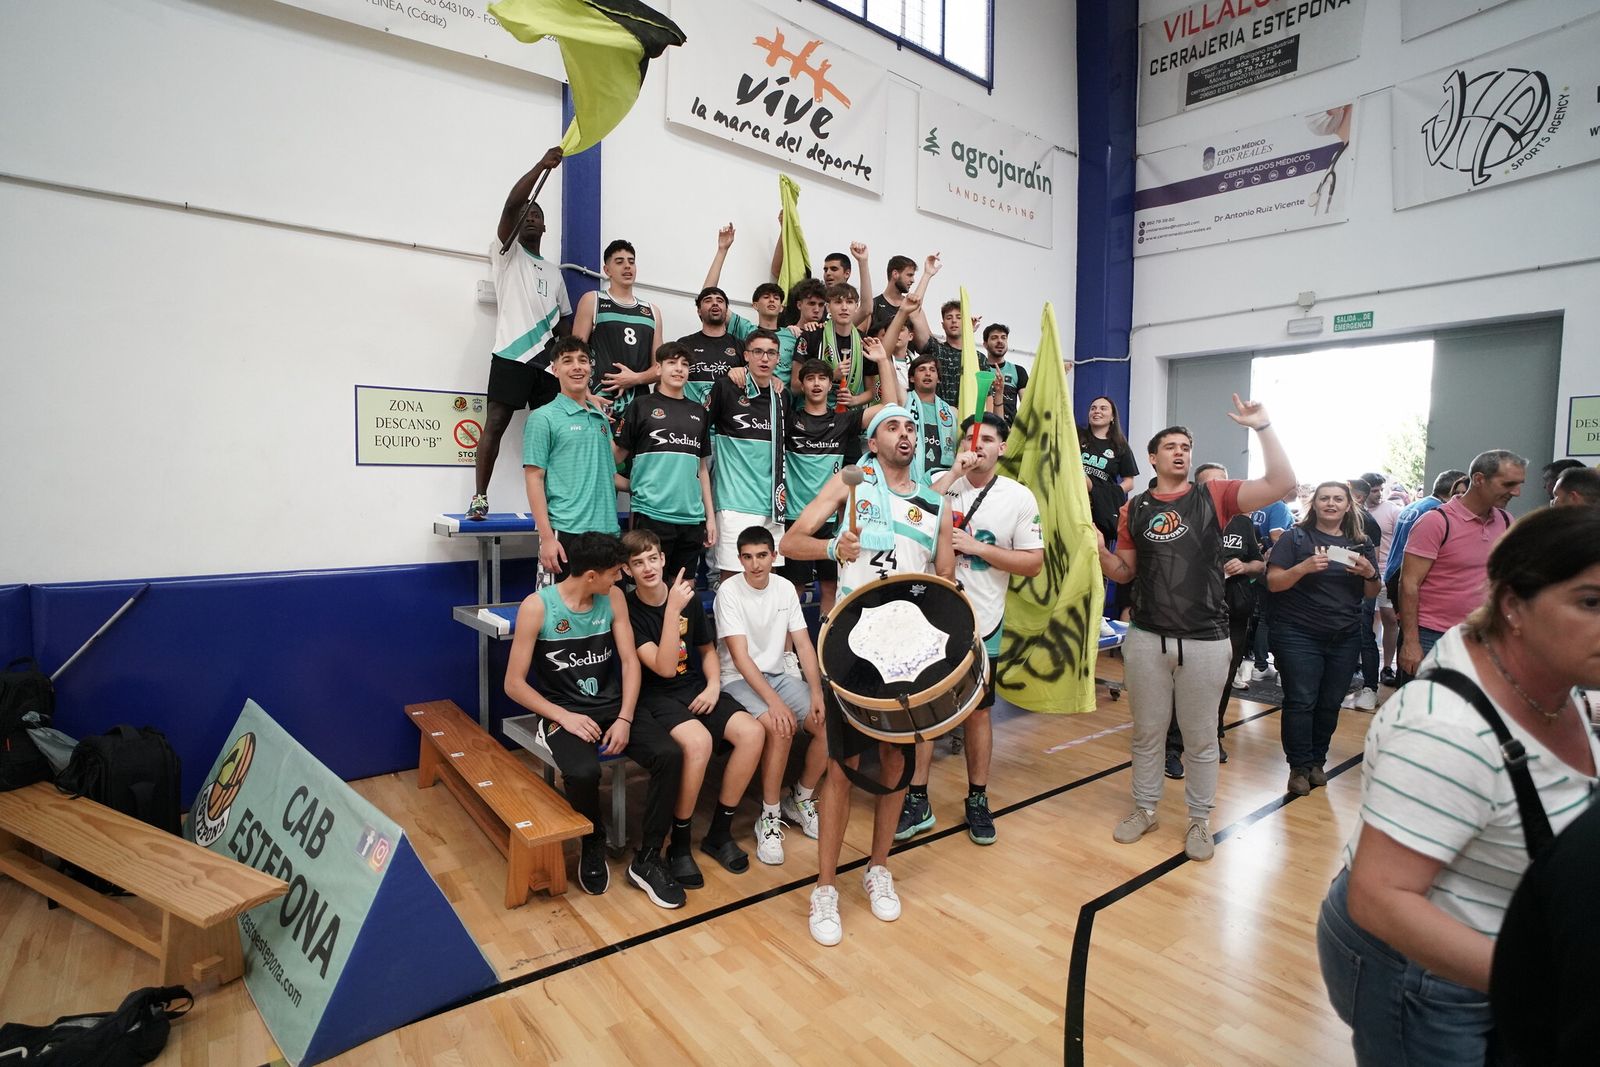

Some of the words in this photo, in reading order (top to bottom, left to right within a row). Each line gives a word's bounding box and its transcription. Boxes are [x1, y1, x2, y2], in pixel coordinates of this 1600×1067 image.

[407, 6, 447, 29] (Cádiz)
[1150, 27, 1245, 76] CERRAJERIA
[1266, 38, 1295, 53] Industrial
[1229, 69, 1243, 78] 605
[1244, 65, 1253, 73] 79
[1254, 62, 1263, 70] 74
[1236, 60, 1250, 69] 952
[1217, 78, 1253, 94] ESTEPONA
[691, 97, 707, 121] la
[713, 111, 770, 143] marca
[775, 129, 801, 154] del
[806, 142, 872, 182] deporte
[1511, 135, 1551, 171] SPORTS
[1547, 93, 1571, 134] AGENCY
[1216, 154, 1237, 166] LOS
[1237, 143, 1274, 161] REALES
[1217, 145, 1241, 157] CENTRO
[1242, 138, 1266, 152] MÉDICO
[1224, 161, 1275, 180] CERTIFICADOS
[1275, 152, 1311, 168] MÉDICOS
[948, 183, 1036, 221] LANDSCAPING
[1214, 214, 1224, 223] Dr
[1224, 208, 1254, 221] Antonio
[1274, 198, 1306, 211] Vicente
[1334, 321, 1372, 331] EMERGENCIA
[1336, 315, 1357, 324] SALIDA
[1363, 312, 1371, 320] DE
[623, 327, 637, 346] 8
[389, 399, 424, 413] ZONA
[375, 416, 441, 431] DESCANSO
[752, 417, 772, 430] Sedi
[1576, 418, 1600, 429] DES
[374, 435, 420, 449] EQUIPO
[833, 461, 839, 474] 8
[1082, 452, 1108, 470] CAB
[1146, 525, 1186, 541] ESTEPONA
[870, 545, 898, 570] 24
[576, 676, 599, 697] 30
[196, 789, 226, 842] ESTEPONA
[282, 785, 335, 860] CAB
